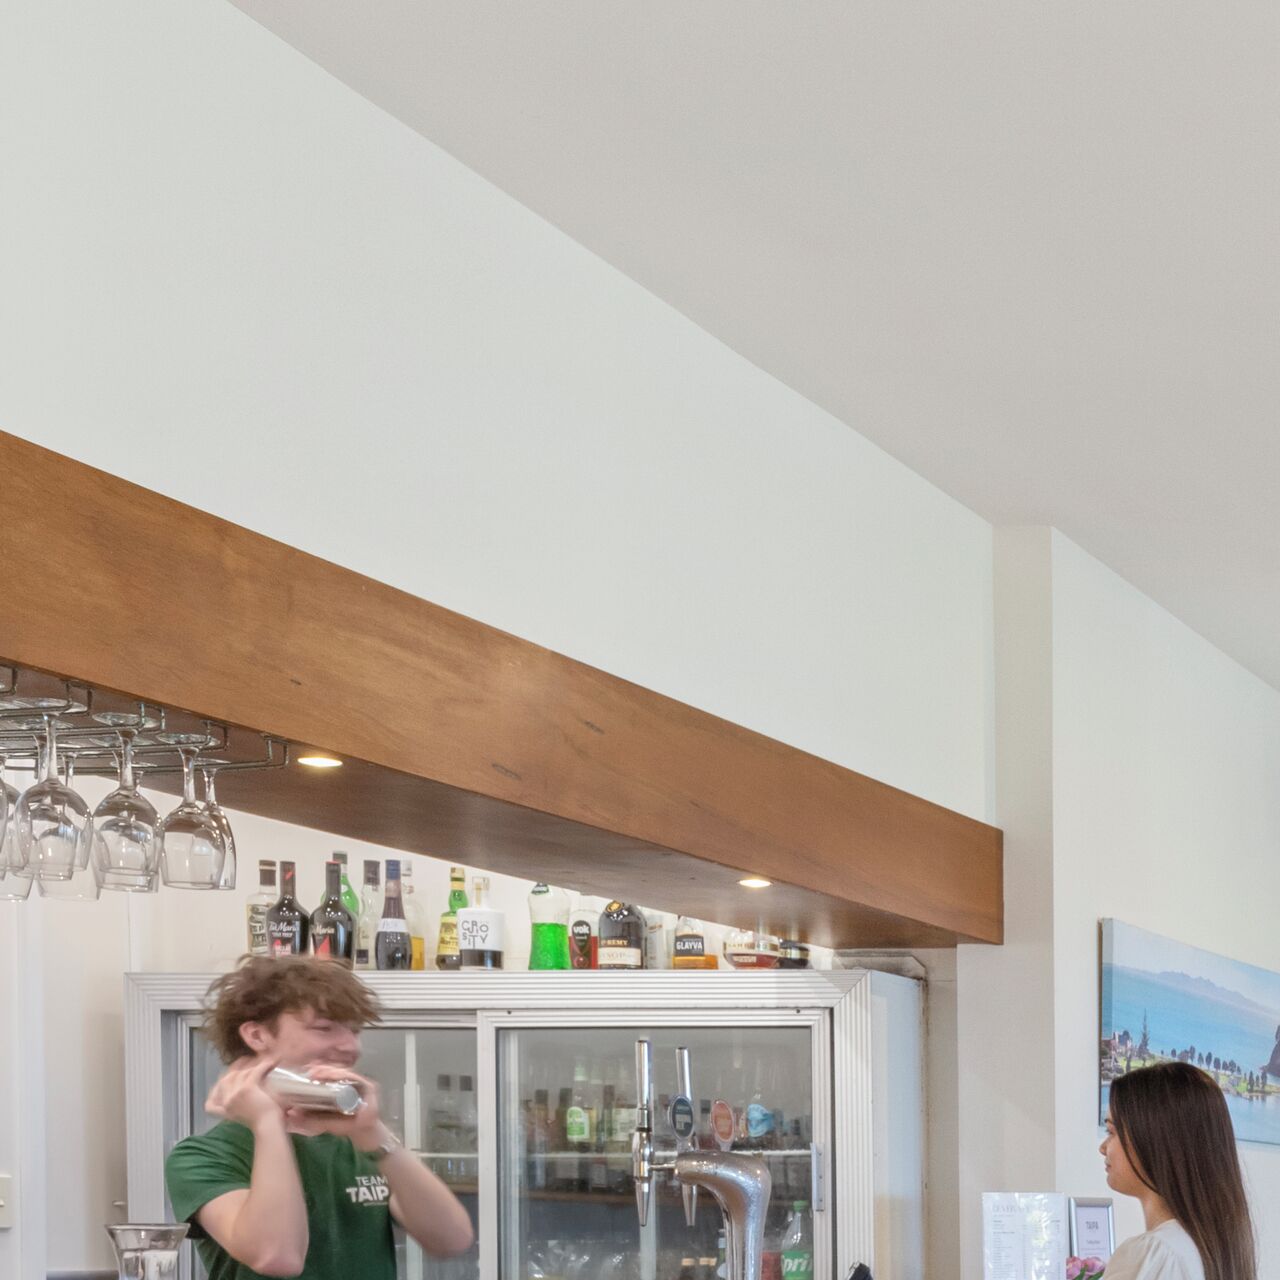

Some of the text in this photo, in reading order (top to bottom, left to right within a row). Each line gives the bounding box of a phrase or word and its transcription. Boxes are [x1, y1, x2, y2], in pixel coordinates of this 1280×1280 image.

[676, 941, 703, 950] GLAYVA
[355, 1176, 389, 1186] TEAM
[345, 1185, 389, 1203] TAIP
[781, 1253, 813, 1275] pri
